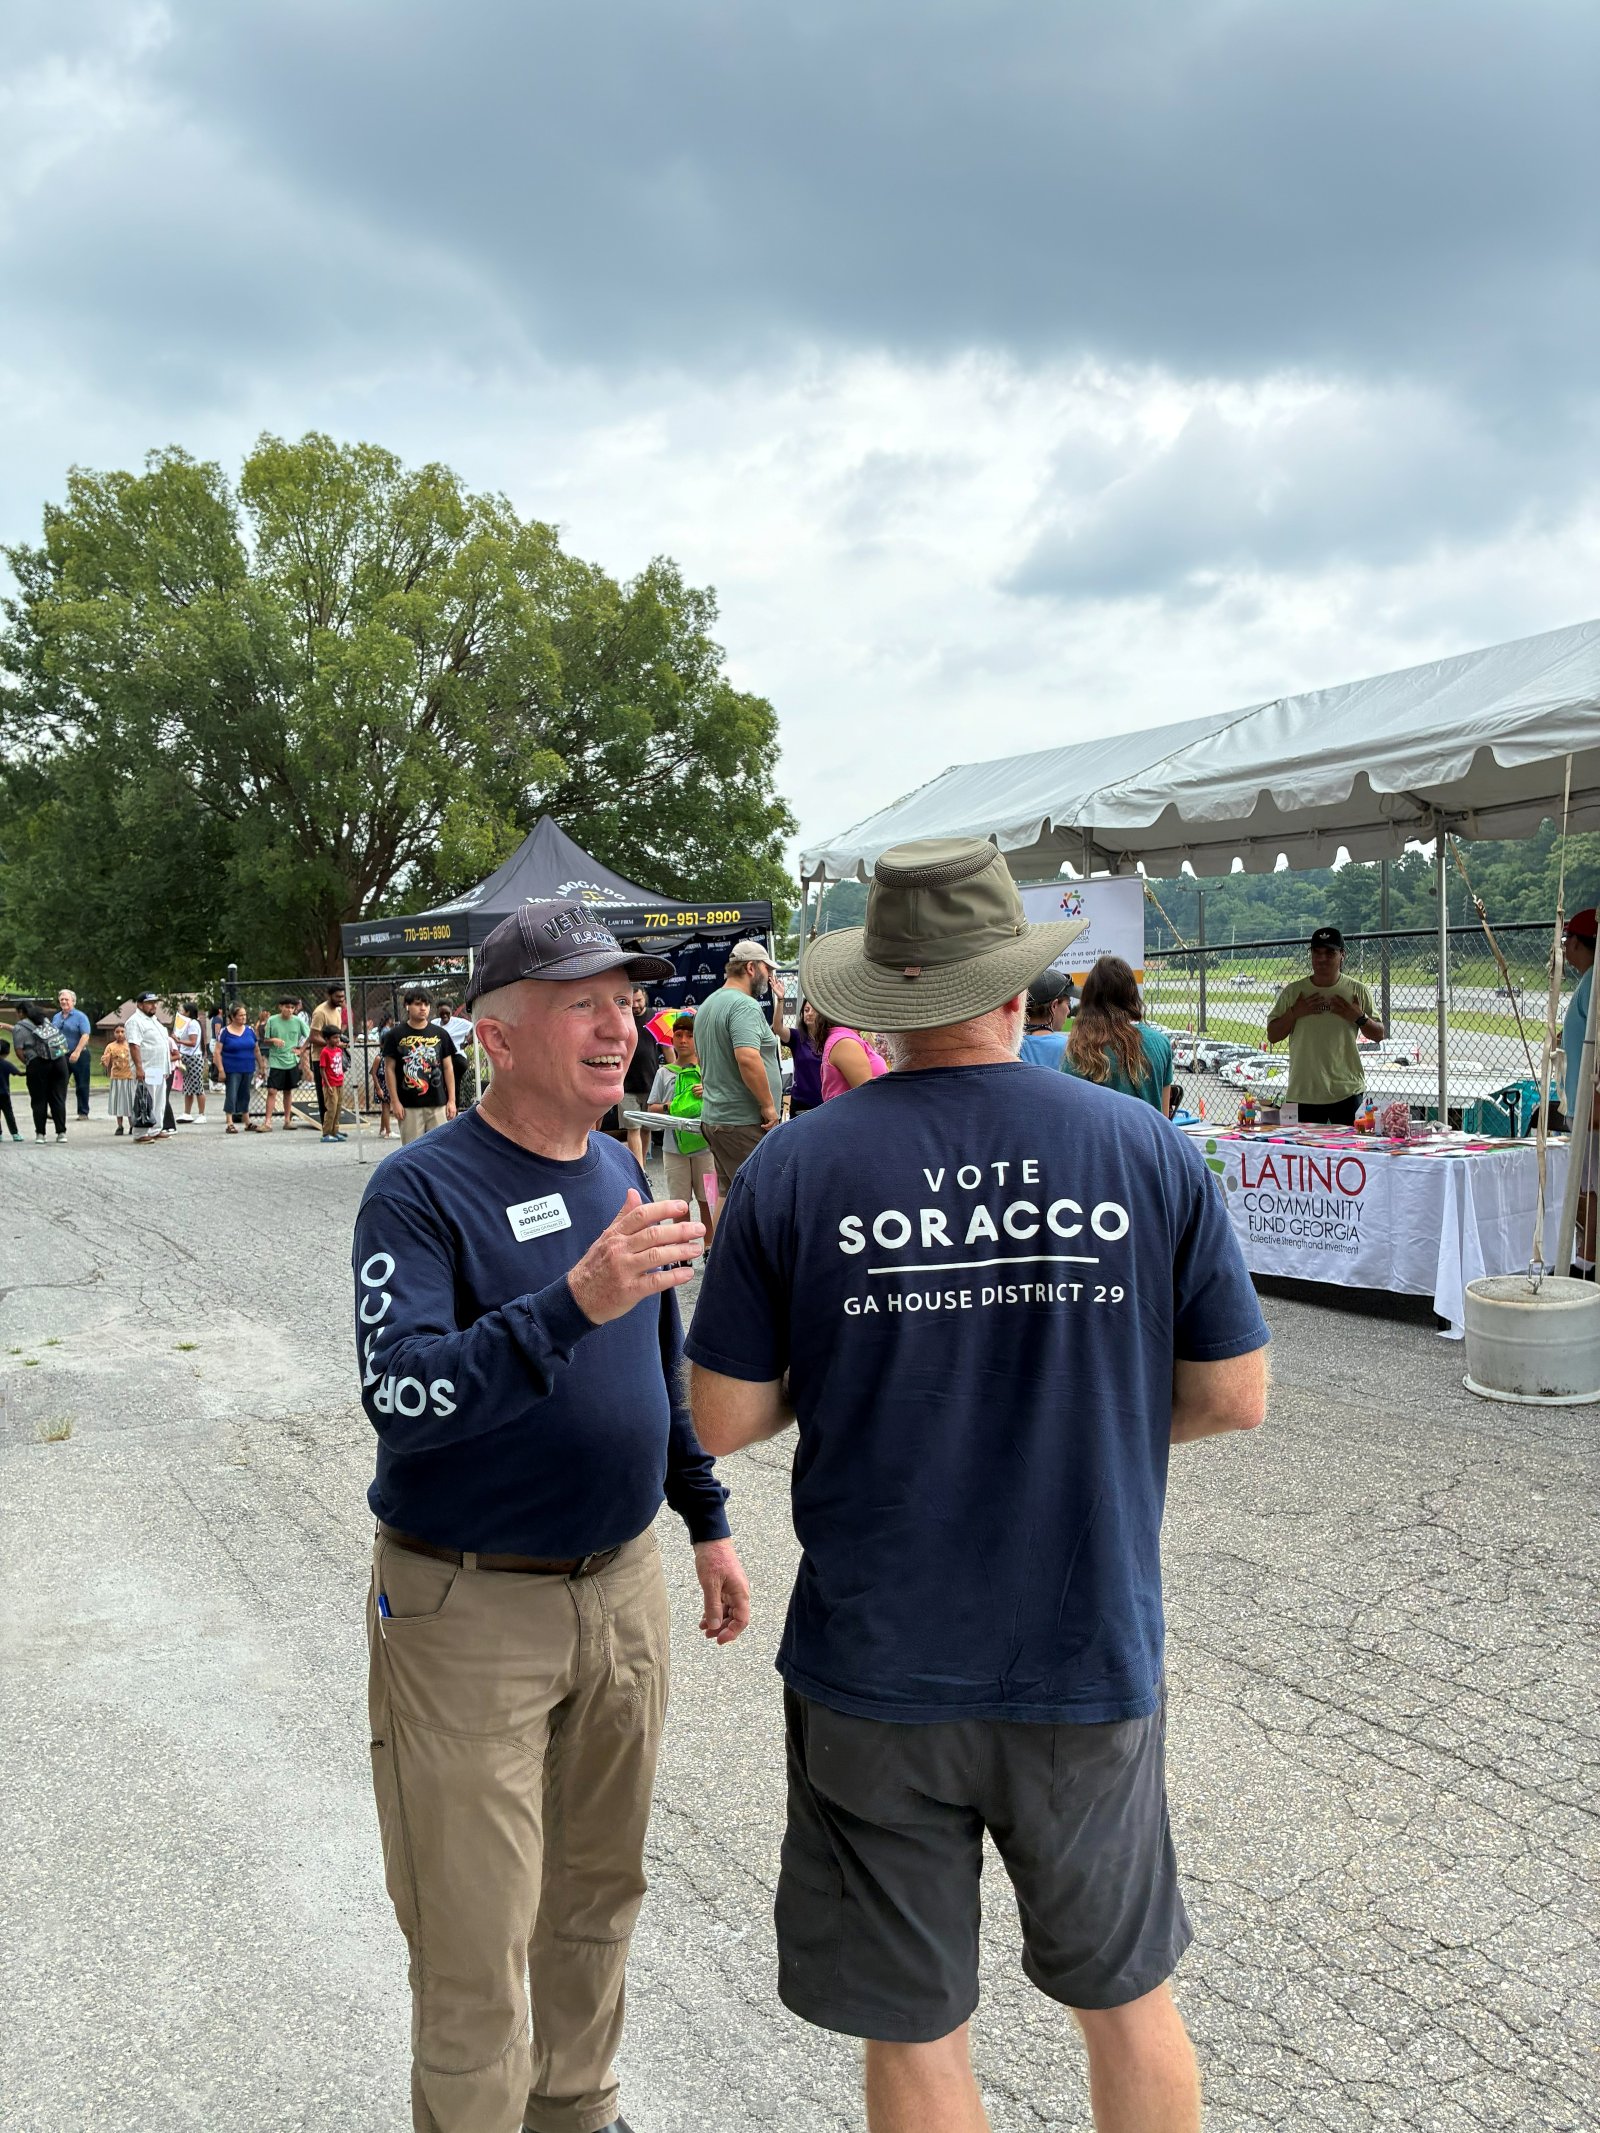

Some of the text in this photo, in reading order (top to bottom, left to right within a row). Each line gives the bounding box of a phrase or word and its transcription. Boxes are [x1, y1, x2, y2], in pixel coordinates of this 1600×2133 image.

[555, 880, 627, 901] ABOGADO
[621, 918, 634, 926] FIRM
[643, 910, 741, 928] 770-951-8900
[403, 925, 451, 942] 770-951-8900
[922, 1159, 1040, 1192] VOTE
[1241, 1152, 1367, 1196] LATINO
[522, 1201, 548, 1214] SCOTT
[1243, 1192, 1365, 1222] COMMUNITY
[519, 1209, 560, 1227] SORACCO
[838, 1198, 1130, 1255] SORACCO
[1248, 1215, 1361, 1243] FUND GEORGIA
[1281, 1235, 1307, 1249] Strength
[1308, 1240, 1324, 1250] and
[843, 1283, 1125, 1315] GA HOUSE DISTRICT 29
